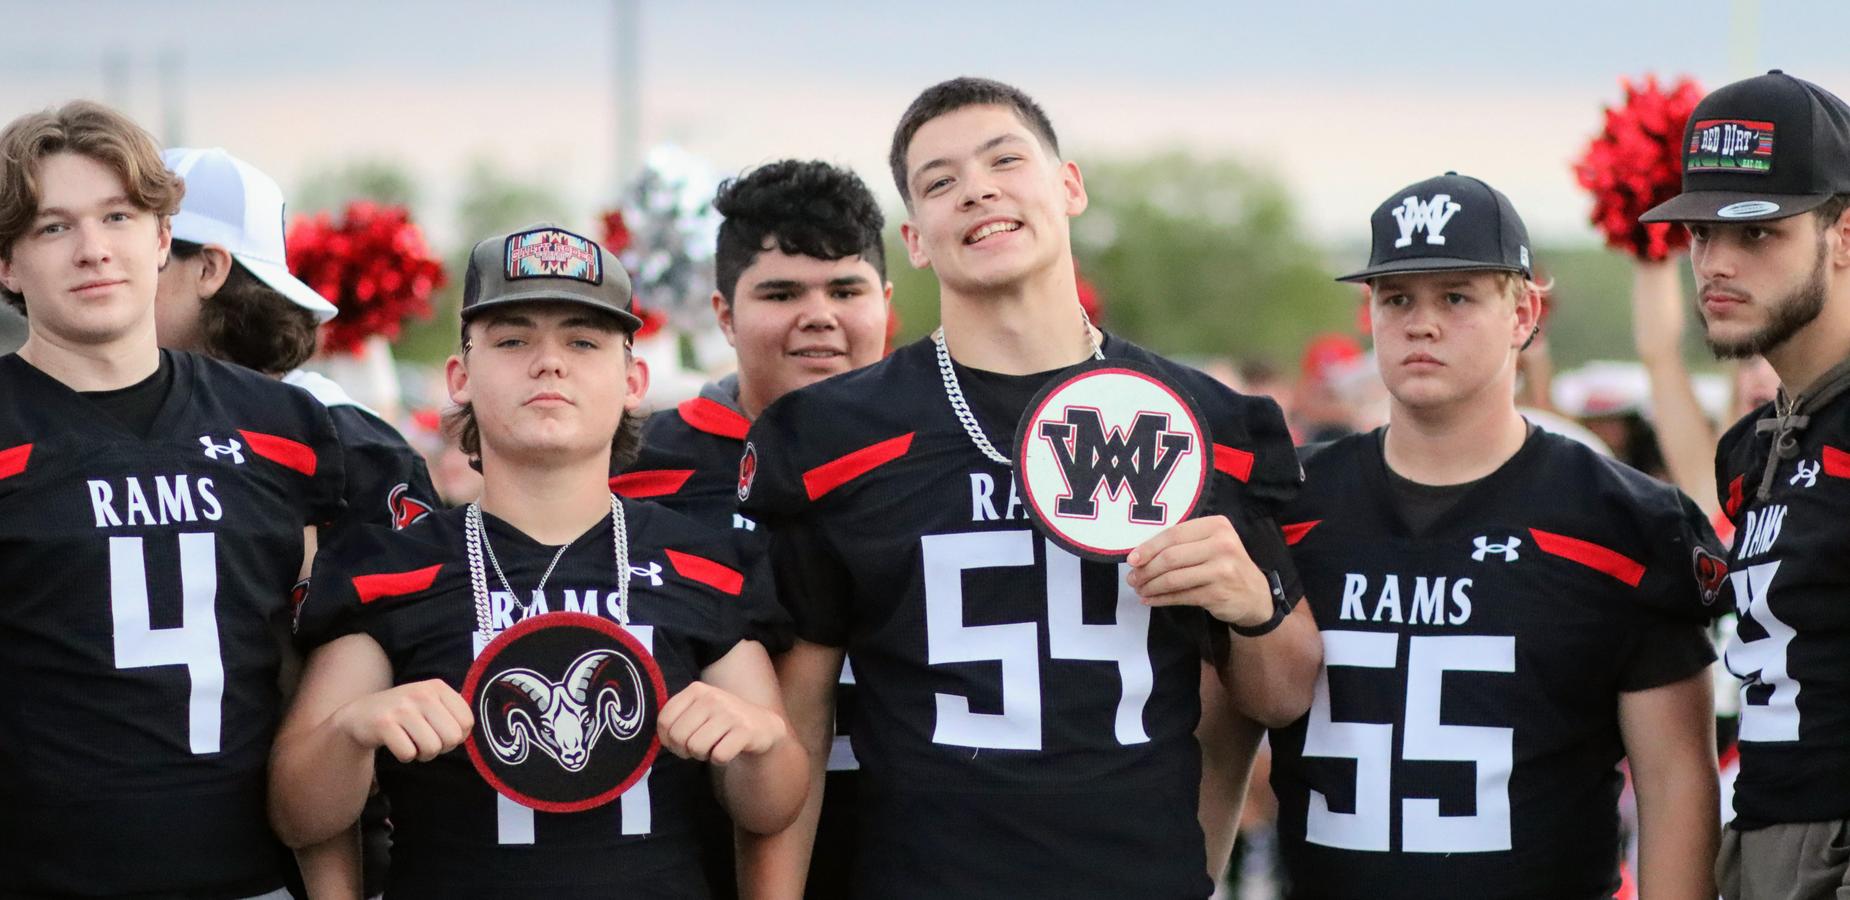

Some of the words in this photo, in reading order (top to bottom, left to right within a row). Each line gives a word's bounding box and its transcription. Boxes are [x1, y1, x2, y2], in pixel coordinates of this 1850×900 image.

[1701, 126, 1720, 153] RED
[1722, 124, 1752, 156] DIRT
[87, 474, 222, 527] RAMS
[108, 532, 225, 754] 4
[920, 529, 1154, 751] 54
[1340, 573, 1473, 626] RAMS
[1301, 630, 1516, 853] 55
